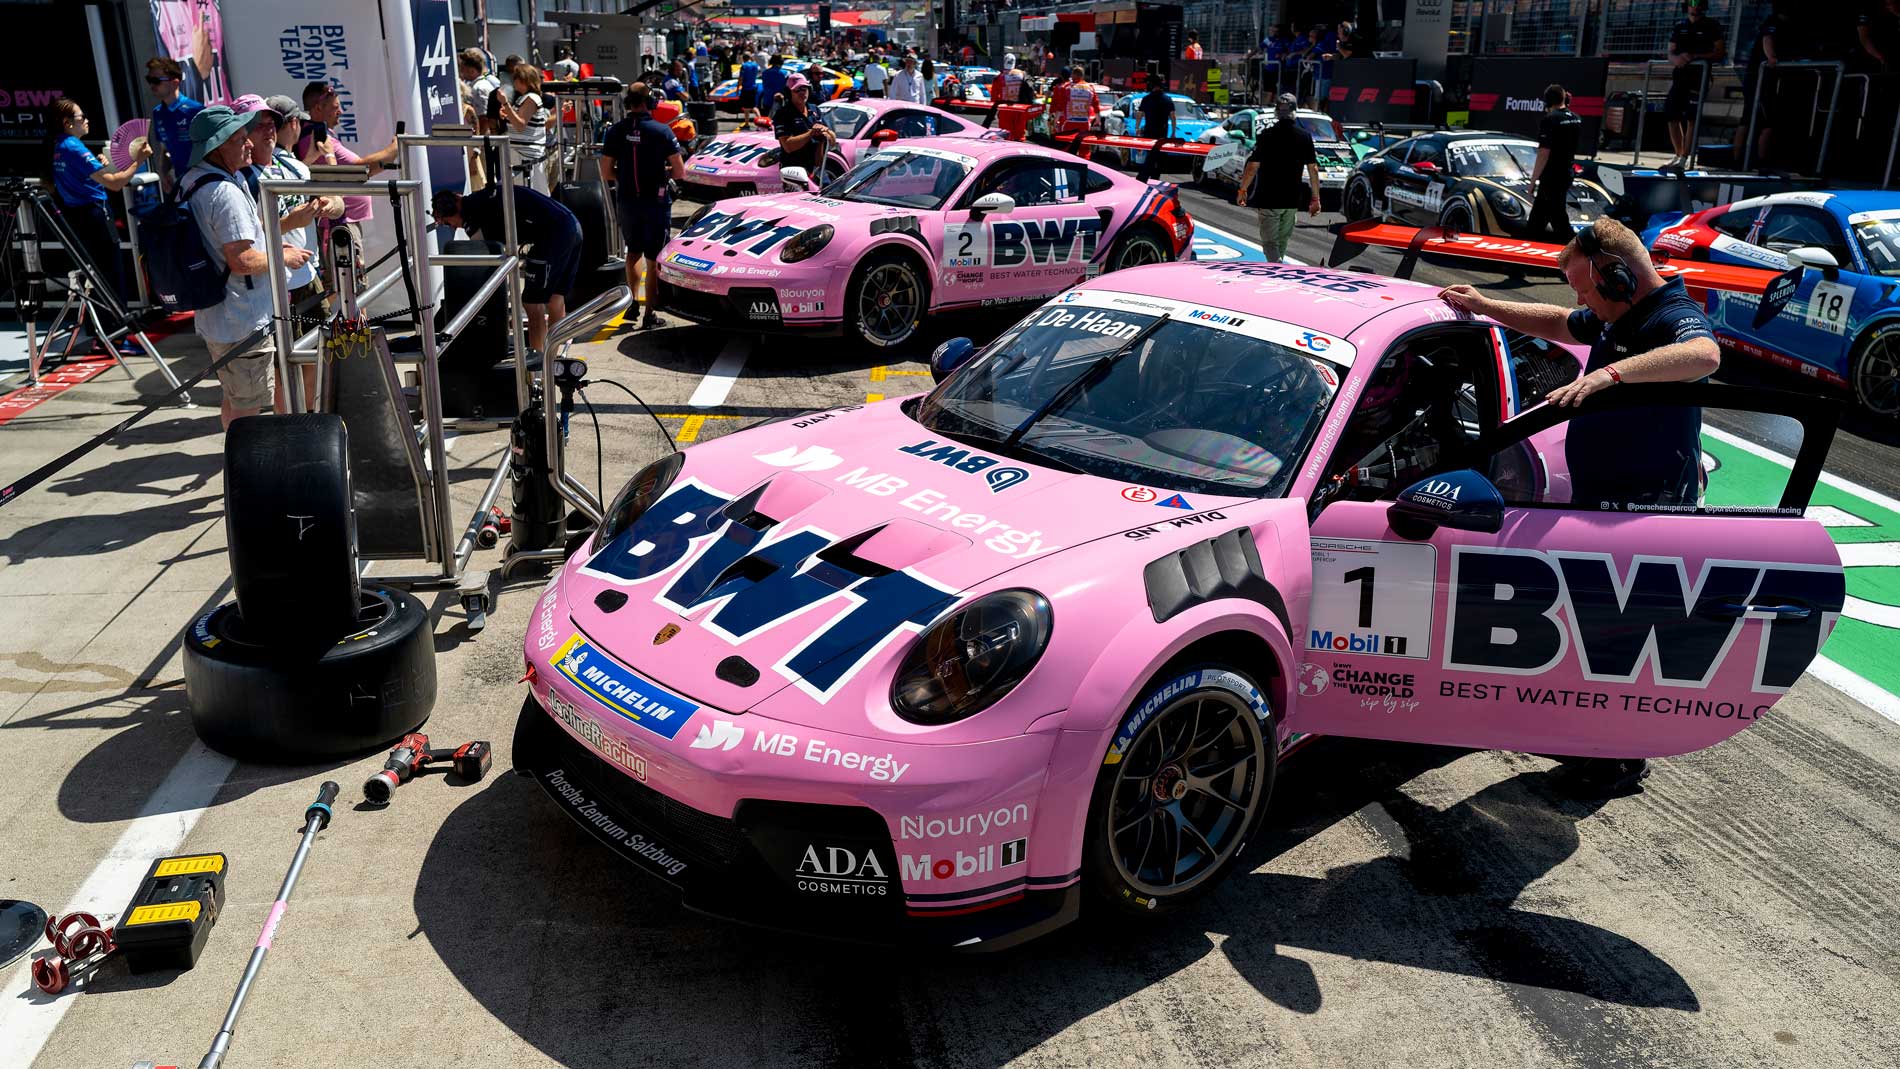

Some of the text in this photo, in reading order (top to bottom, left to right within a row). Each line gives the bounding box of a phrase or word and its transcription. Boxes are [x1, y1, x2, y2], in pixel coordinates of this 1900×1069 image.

[279, 27, 306, 80] TEAM
[301, 25, 328, 80] FORM
[323, 25, 349, 69] BWT
[1506, 97, 1545, 112] Formula
[1454, 152, 1482, 166] 11
[679, 210, 805, 260] BWT
[957, 232, 973, 257] 2
[990, 217, 1102, 268] BWT
[747, 267, 781, 278] Energy
[949, 258, 972, 267] Mobil
[990, 272, 1012, 280] BEST
[1013, 270, 1042, 279] WATER
[750, 302, 779, 314] ADA
[780, 288, 825, 302] Nouryon
[782, 302, 824, 314] Mobil 1
[1817, 291, 1844, 323] 18
[1037, 308, 1071, 327] De
[1071, 311, 1143, 340] Haan
[1188, 309, 1231, 324] Mobil
[1811, 318, 1831, 330] Mobil
[1295, 331, 1332, 352] 30
[1305, 375, 1362, 480] www.porsche.com/pmsc
[898, 439, 1000, 476] BWT
[1413, 494, 1453, 511] COSMETICS
[1418, 480, 1462, 501] ADA
[834, 466, 1064, 560] MB Energy
[1627, 502, 1802, 516] @porschesupercup @porsche.customerracing
[578, 475, 978, 705] BWT
[1343, 566, 1376, 629] 1
[538, 602, 559, 652] Energy
[1442, 544, 1846, 694] BWT
[1311, 630, 1380, 653] Mobil
[582, 664, 677, 722] MICHELIN
[1332, 669, 1415, 687] CHANGE
[1332, 682, 1415, 699] THE WORLD
[1127, 673, 1198, 736] MICHELIN
[1360, 692, 1421, 714] sip by sip
[1439, 680, 1507, 702] BEST
[1516, 686, 1610, 711] WATER
[752, 729, 912, 784] MB Energy
[545, 768, 688, 877] Porsche Zentrum Salzburg
[900, 802, 1028, 842] Nouryon
[796, 843, 889, 879] ADA
[900, 845, 994, 882] Mobil
[797, 880, 888, 896] COSMETICS
